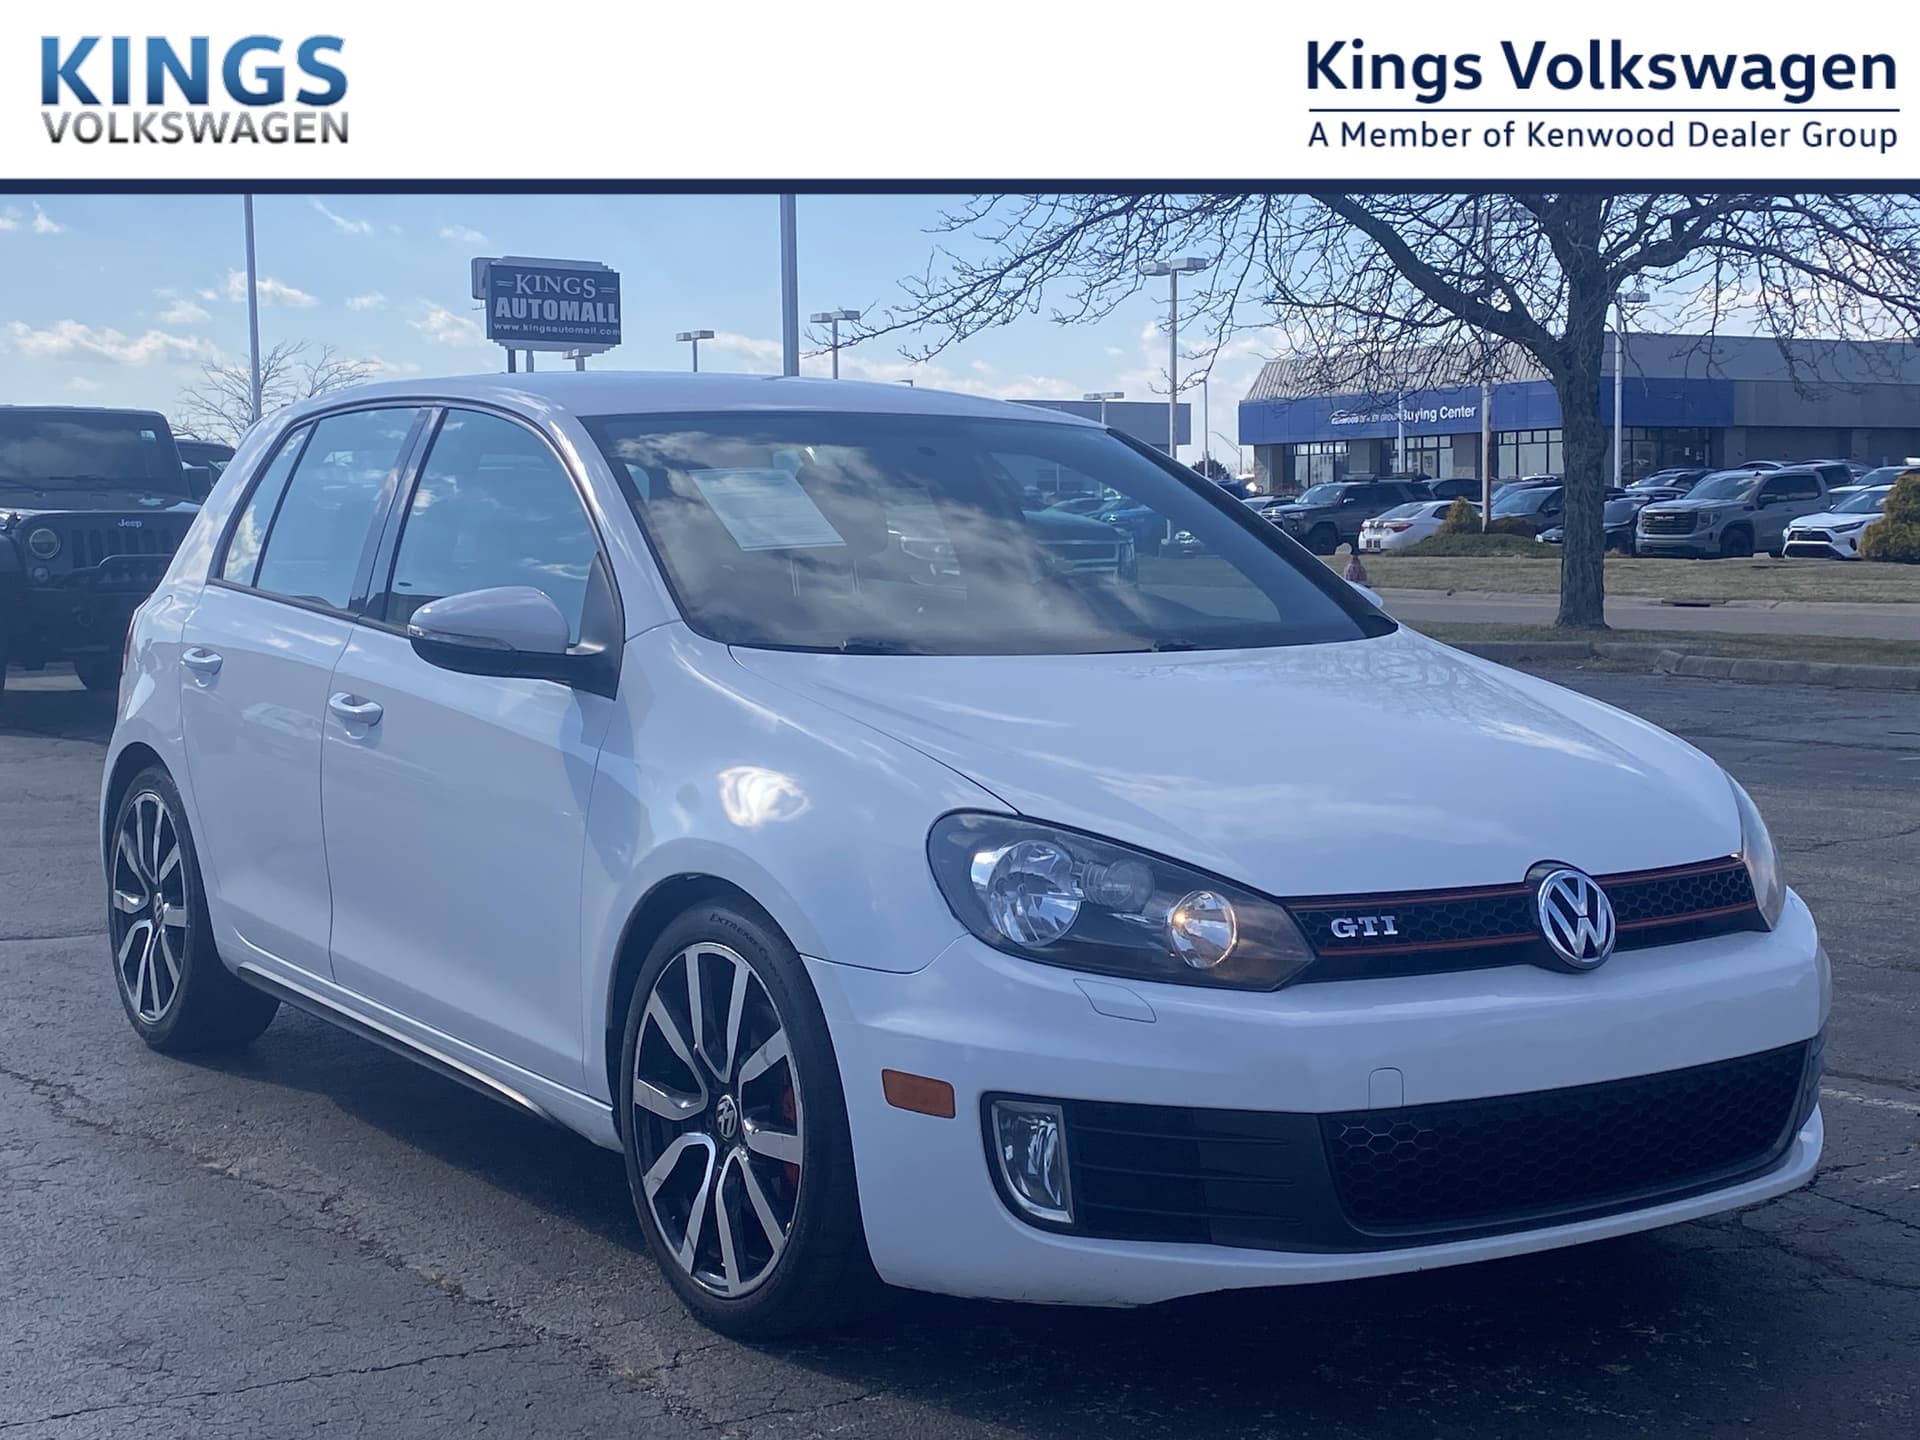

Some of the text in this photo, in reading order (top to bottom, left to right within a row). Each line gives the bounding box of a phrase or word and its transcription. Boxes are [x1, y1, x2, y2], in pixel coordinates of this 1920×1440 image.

[514, 273, 596, 299] KINGS
[495, 296, 619, 323] AUTOMALL
[1439, 405, 1477, 419] Center
[117, 518, 143, 528] Jeep
[1330, 915, 1399, 938] GTI
